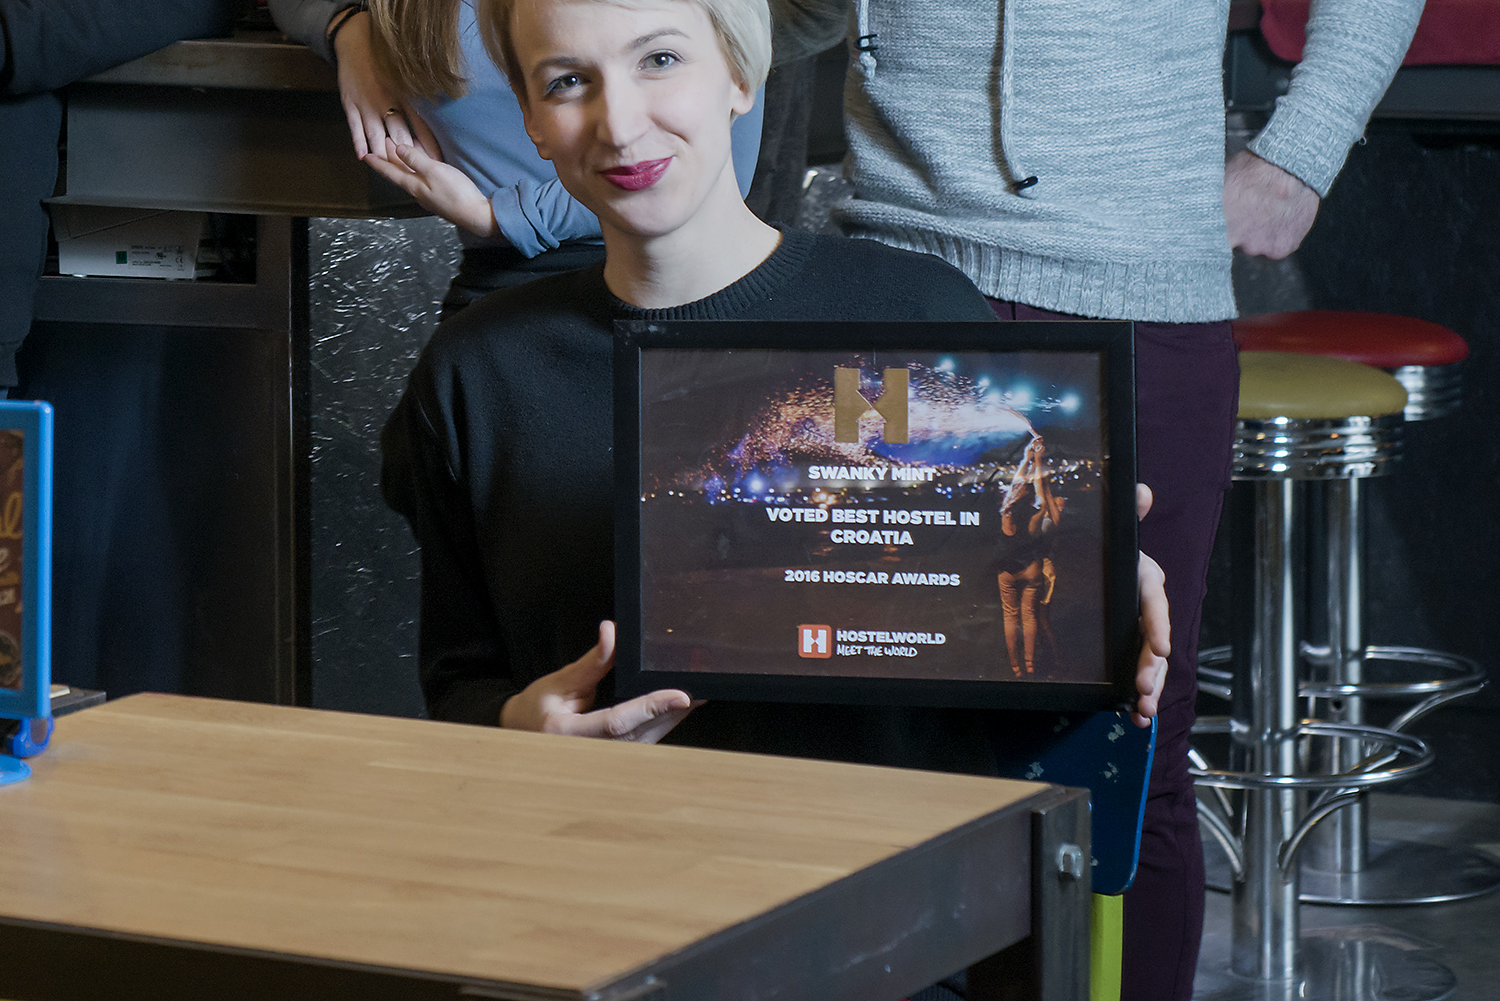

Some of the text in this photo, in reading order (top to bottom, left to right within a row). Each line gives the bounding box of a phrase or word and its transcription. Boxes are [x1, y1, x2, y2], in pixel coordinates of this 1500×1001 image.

[807, 465, 937, 482] SWANKY MINT
[765, 507, 980, 526] VOTED BEST HOSTEL IN
[829, 529, 915, 546] CROATIA
[784, 569, 961, 587] 2016 HOSCAR AWARDS
[835, 629, 947, 645] HOSTELWORLD
[835, 644, 918, 658] MEET THE WORLD
